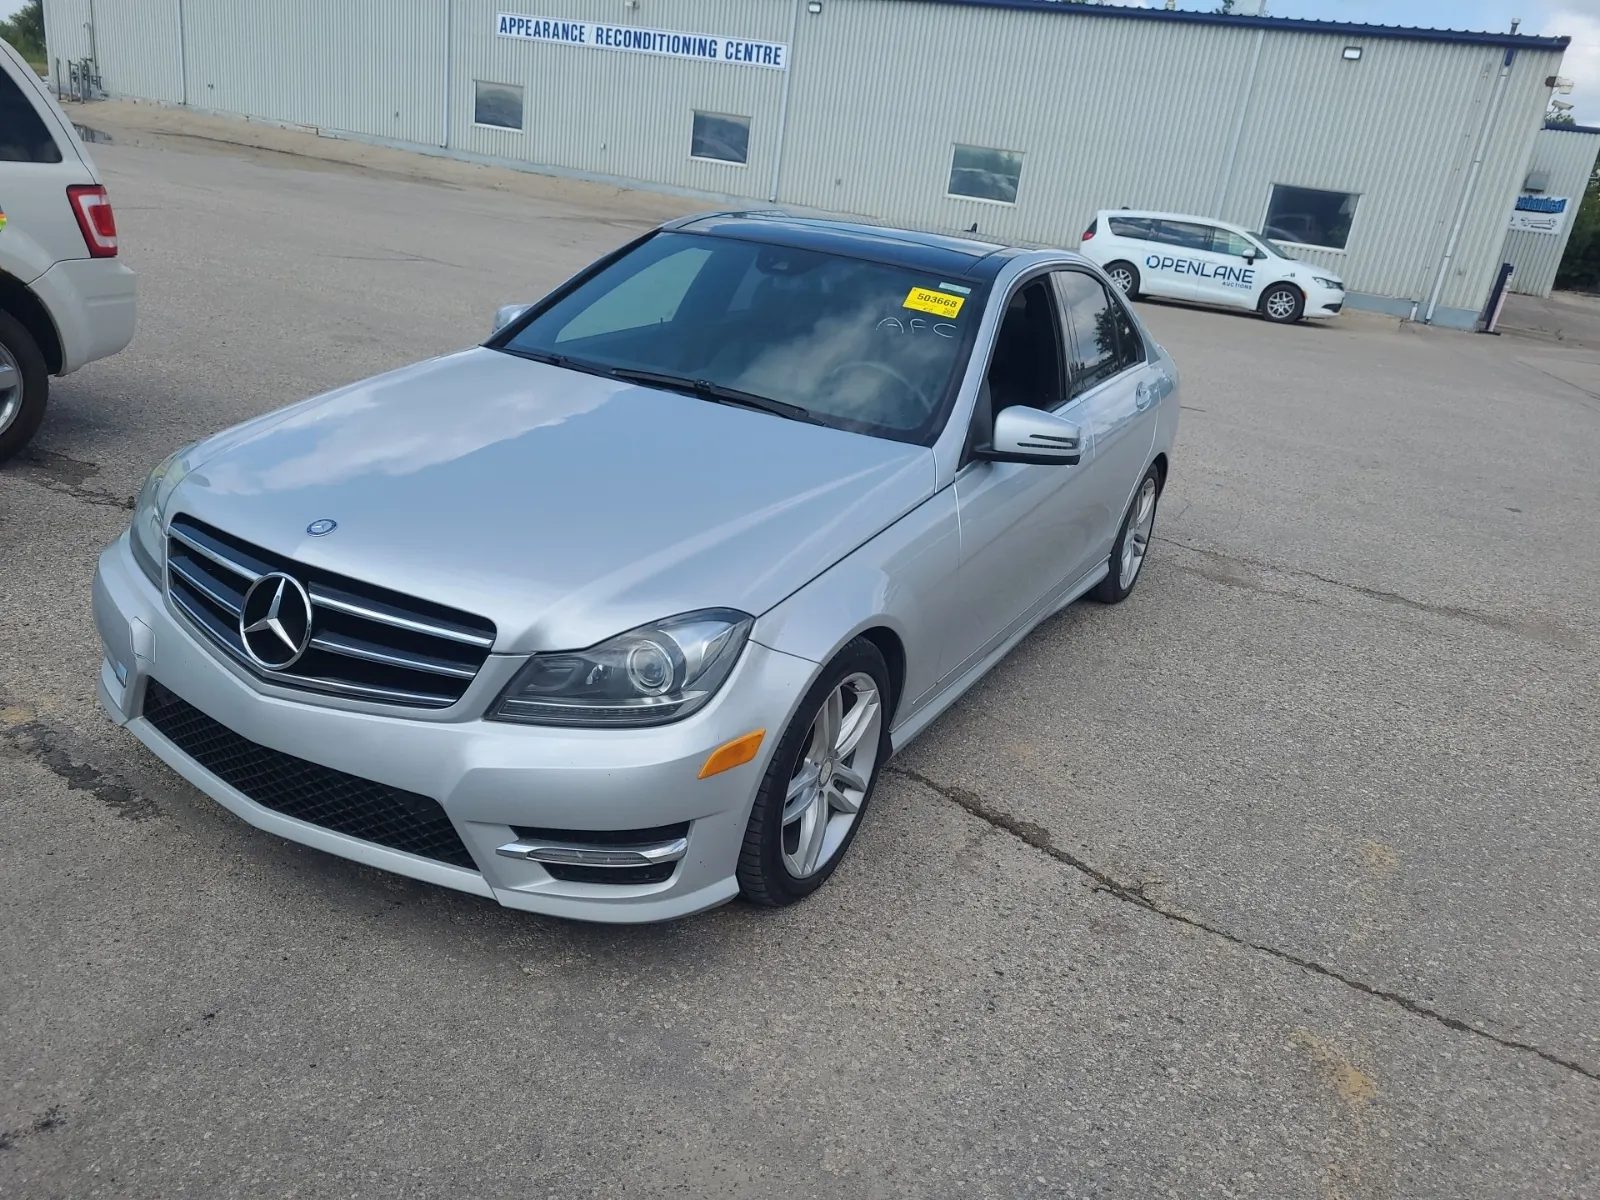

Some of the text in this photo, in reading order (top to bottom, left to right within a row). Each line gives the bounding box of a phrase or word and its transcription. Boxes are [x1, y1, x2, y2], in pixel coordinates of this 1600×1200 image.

[499, 16, 783, 66] APPEARANCE RECONDITIONING CENTRE
[1146, 254, 1256, 284] OPENLANE
[1222, 281, 1253, 291] AUCTIONS
[916, 292, 958, 309] 503668
[875, 316, 957, 339] AFC
